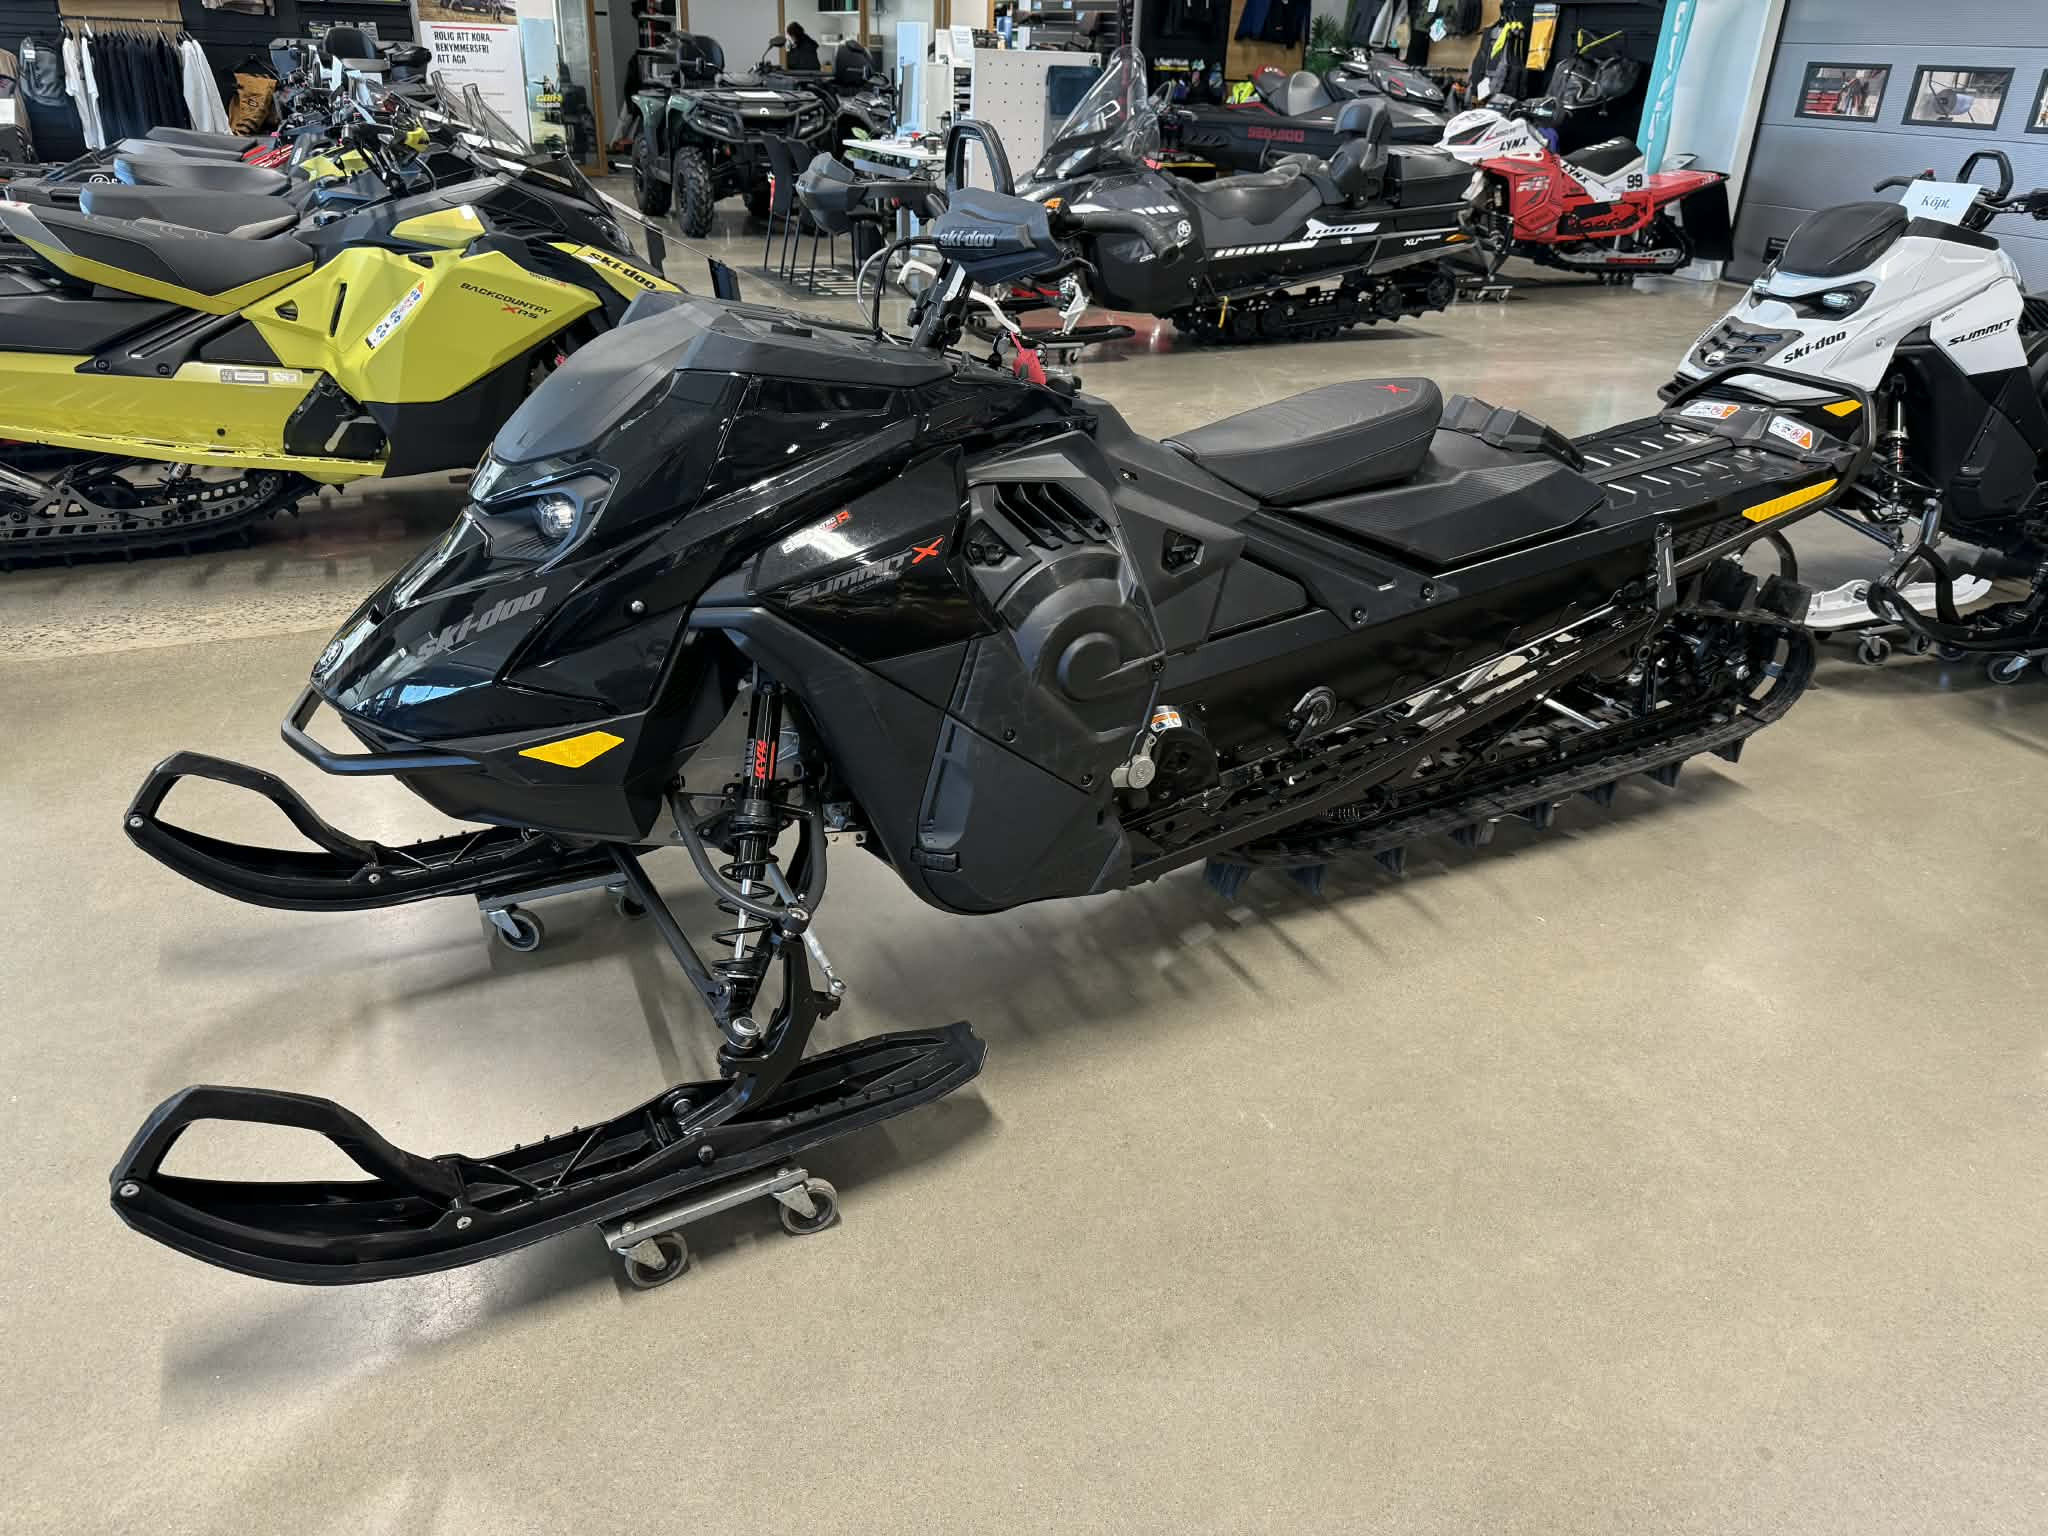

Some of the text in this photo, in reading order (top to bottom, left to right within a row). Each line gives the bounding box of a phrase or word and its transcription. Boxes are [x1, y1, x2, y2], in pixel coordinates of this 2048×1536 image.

[433, 31, 455, 41] ROLIG
[456, 32, 469, 42] ATT
[435, 42, 490, 54] BEKYMMERSFRI
[437, 54, 450, 64] ATT
[1499, 136, 1529, 151] LYNX
[1561, 163, 1590, 184] LYNX
[1627, 173, 1643, 189] 99
[939, 230, 996, 248] ski-doo
[589, 252, 657, 290] ski-doo
[459, 282, 553, 314] BACKCOUNTRY
[1947, 318, 2015, 347] SUMMIT
[1783, 330, 1848, 365] ski-doo
[785, 550, 914, 607] SUMMIT
[416, 586, 548, 667] ski-doo
